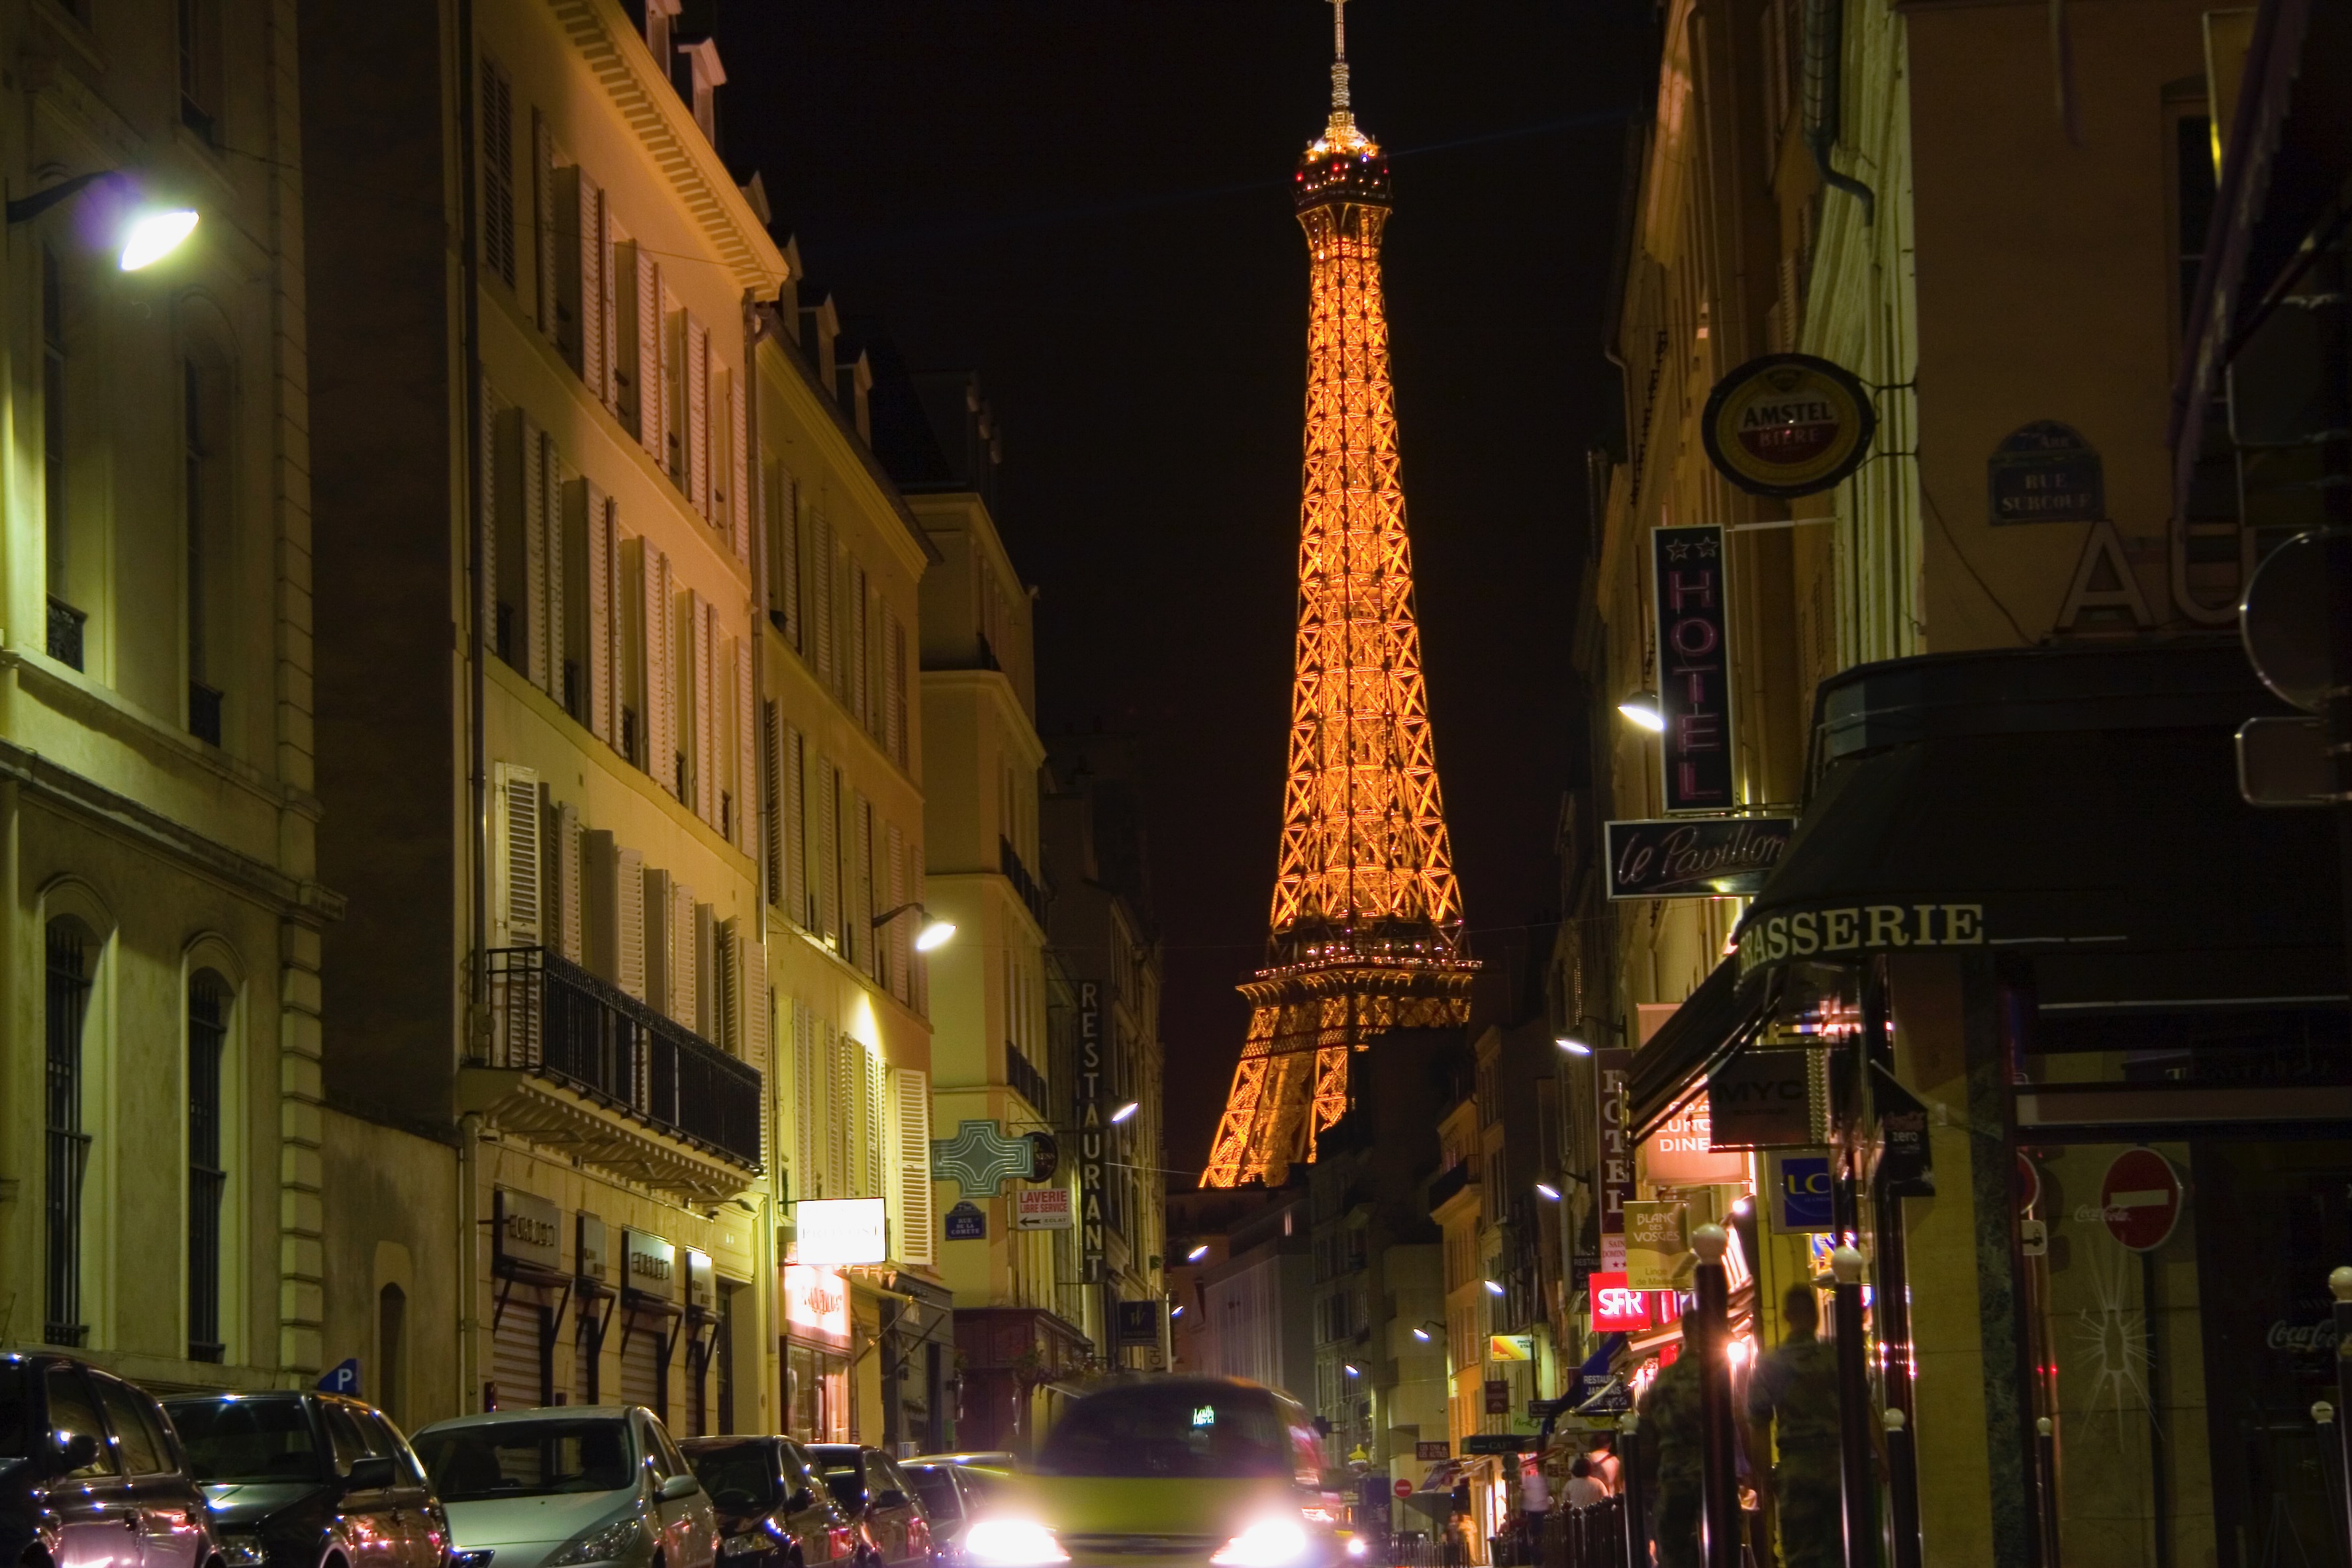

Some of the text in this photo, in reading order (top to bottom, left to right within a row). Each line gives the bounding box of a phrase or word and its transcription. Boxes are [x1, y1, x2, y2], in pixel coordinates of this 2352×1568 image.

[1745, 401, 1833, 428] AMSTEL
[2024, 472, 2068, 490] RUE
[1667, 570, 1723, 801] HOTEL
[1659, 824, 1786, 877] Pavillon
[1716, 1079, 1804, 1102] MYC
[1081, 982, 1103, 1281] RESTAURANT
[1655, 1118, 1711, 1133] LUNC
[1659, 1137, 1711, 1153] DINE
[1893, 1132, 1918, 1142] zero
[1020, 1191, 1068, 1204] LAVERIE
[1020, 1202, 1068, 1214] LIBRE SERVICE
[1636, 1213, 1675, 1226] BLANC
[1633, 1231, 1680, 1242] VOSGES
[1598, 1287, 1644, 1315] SFR
[337, 1368, 353, 1389] P
